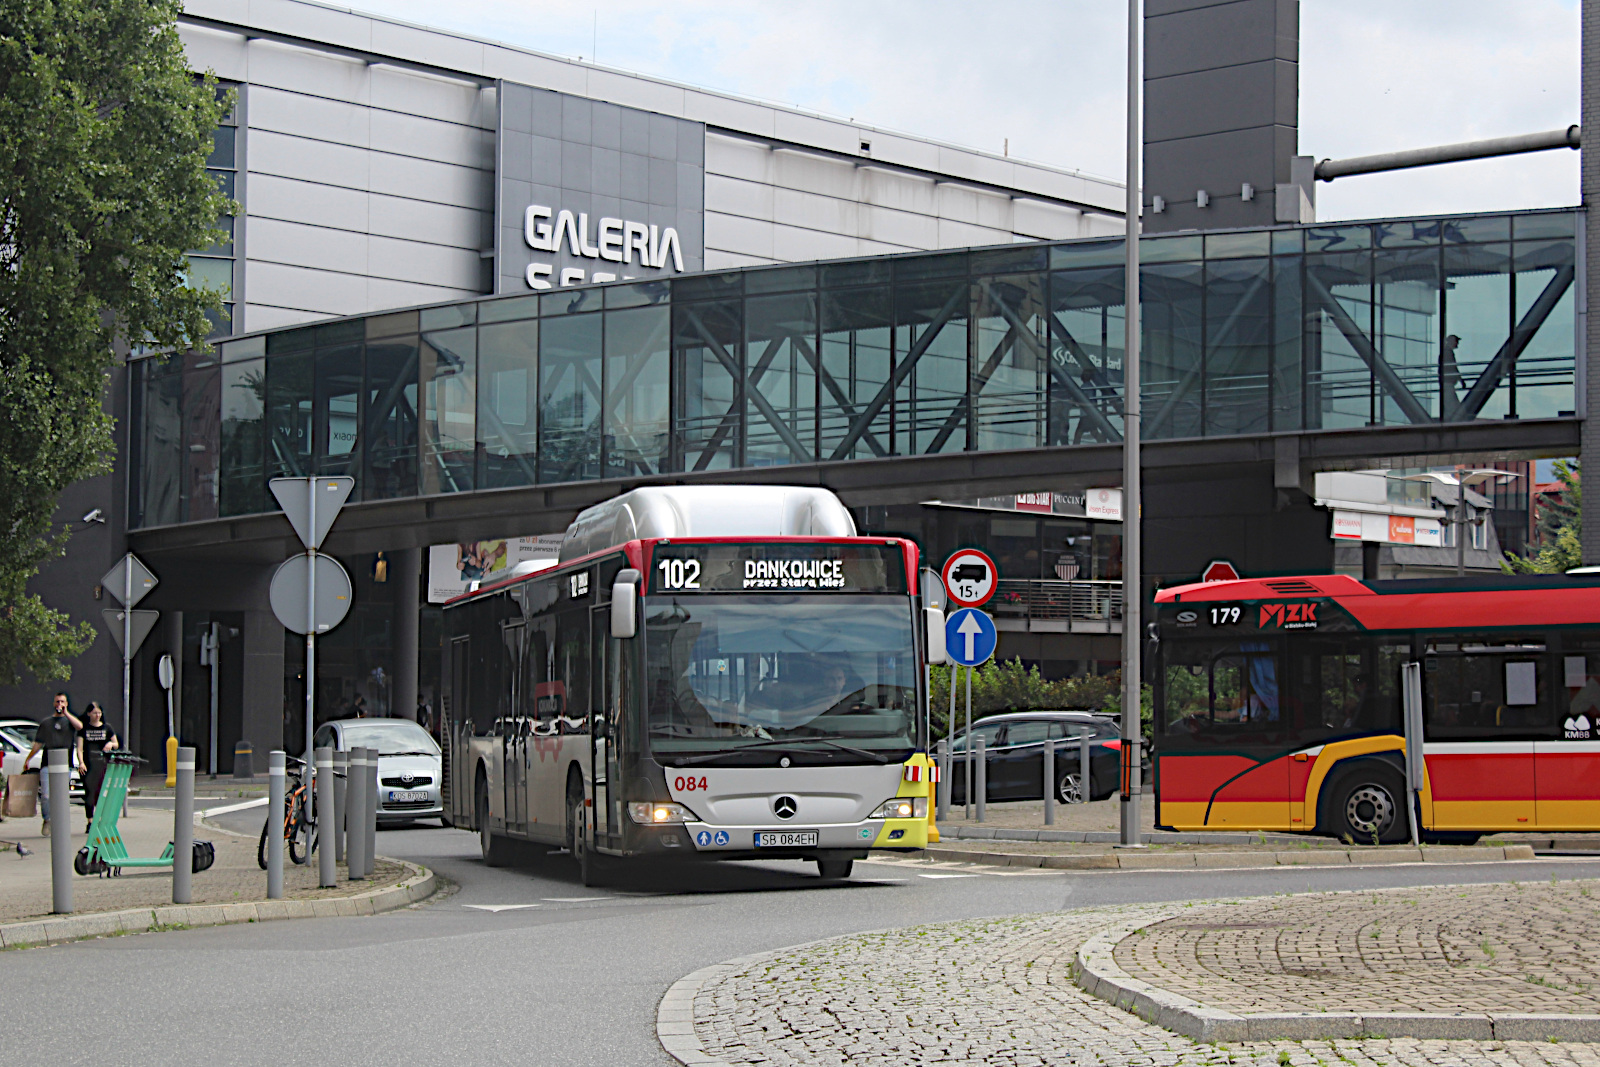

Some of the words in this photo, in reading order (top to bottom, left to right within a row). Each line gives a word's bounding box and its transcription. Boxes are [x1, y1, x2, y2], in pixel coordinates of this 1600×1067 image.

[525, 205, 685, 273] GALERIA
[1088, 505, 1101, 513] Vision
[1102, 506, 1120, 516] Express
[658, 559, 701, 589] 102
[744, 560, 843, 579] DANKOWICE
[743, 578, 779, 588] przez
[819, 577, 845, 588] Wieś
[959, 585, 973, 598] 15
[975, 590, 979, 598] t
[1210, 606, 1241, 624] 179
[1259, 603, 1317, 629] MZK
[674, 776, 708, 791] 084
[762, 834, 777, 845] SB
[780, 834, 816, 846] 084EH
